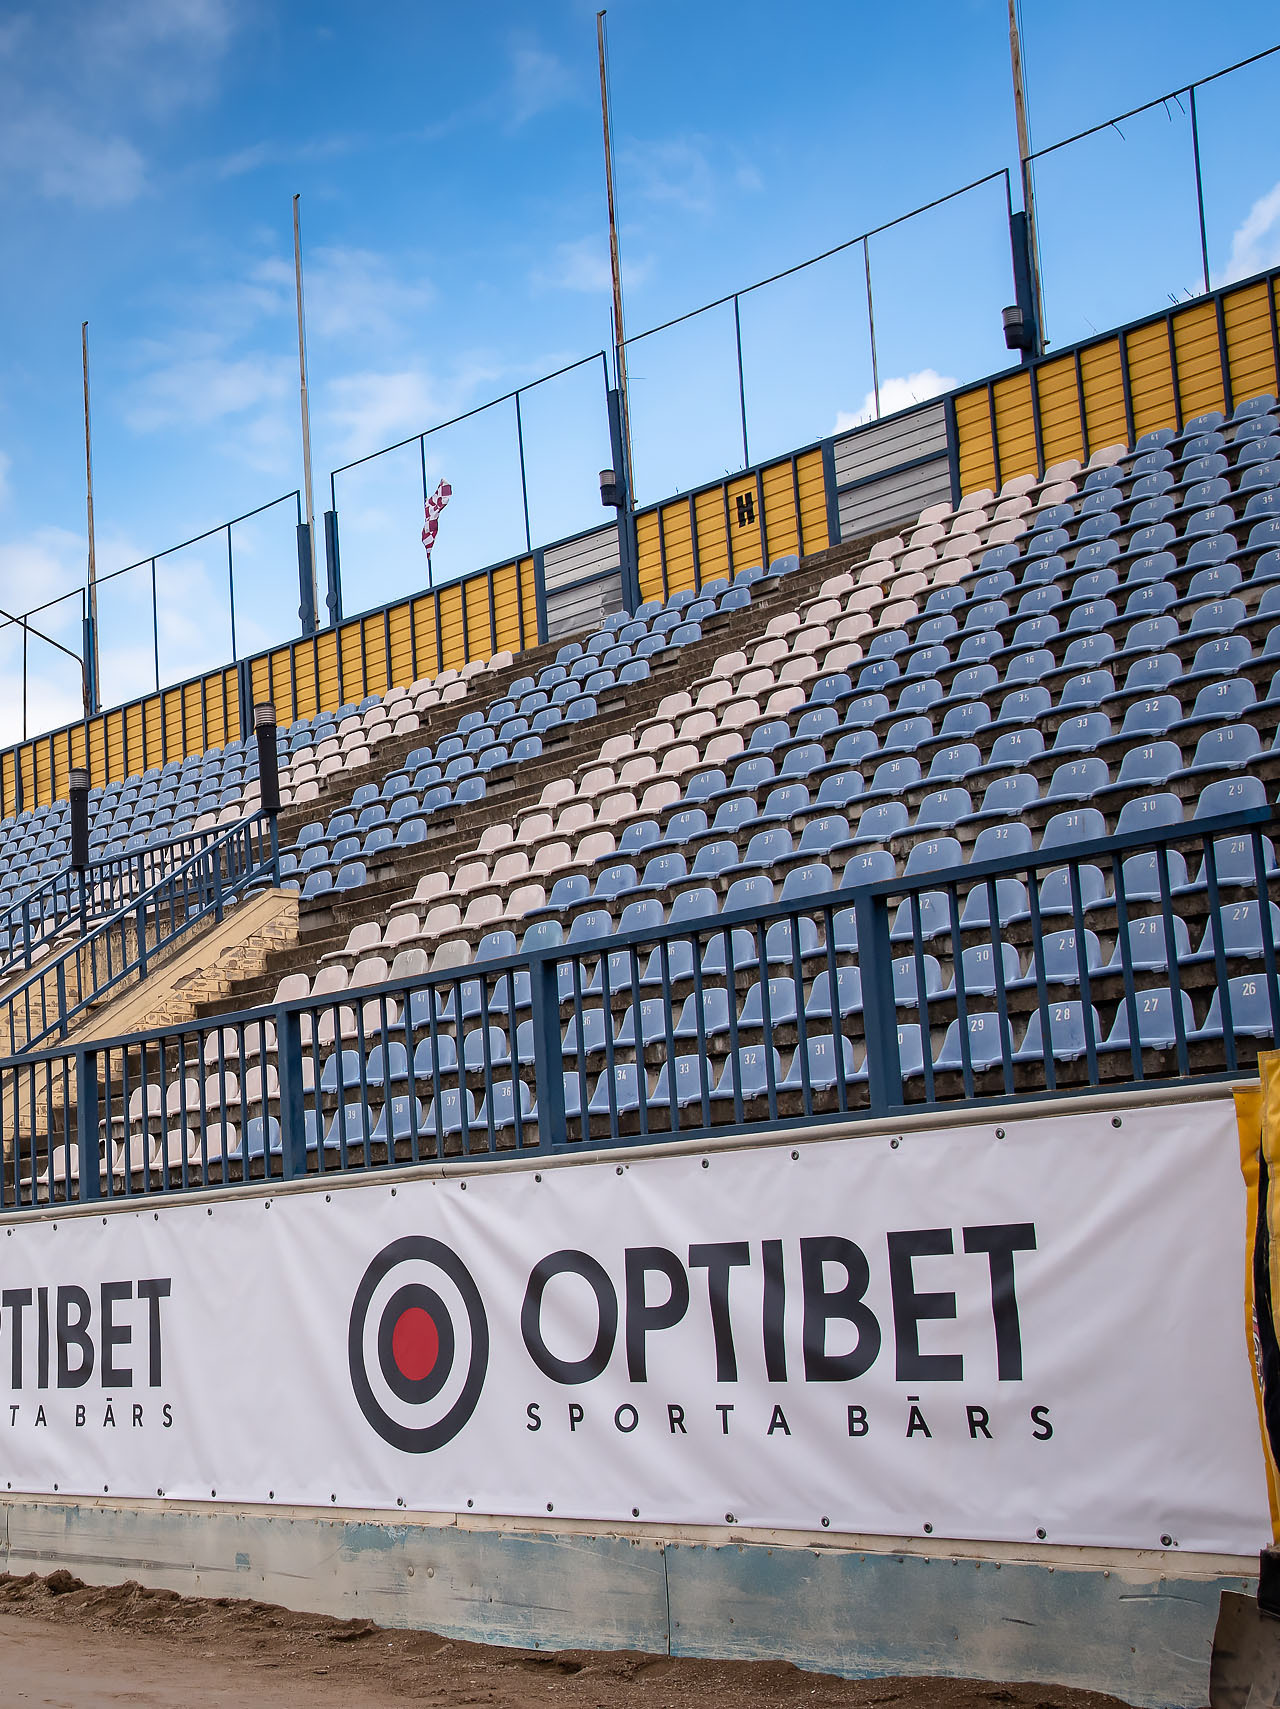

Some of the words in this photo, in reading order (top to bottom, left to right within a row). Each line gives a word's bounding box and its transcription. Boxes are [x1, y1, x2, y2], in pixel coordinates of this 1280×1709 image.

[1262, 495, 1273, 504] 35
[736, 492, 755, 528] H
[1205, 511, 1215, 521] 36
[1145, 529, 1155, 539] 37
[1142, 589, 1153, 600] 35
[1084, 607, 1094, 616] 36
[1213, 605, 1223, 615] 33
[1082, 639, 1094, 648] 35
[1214, 642, 1229, 652] 32
[1025, 655, 1034, 664] 36
[1147, 659, 1159, 670] 33
[1217, 687, 1227, 696] 31
[1145, 700, 1159, 712] 32
[1077, 718, 1088, 728] 33
[1217, 730, 1233, 742] 30
[1143, 749, 1153, 759] 31
[1071, 764, 1086, 775] 32
[1229, 784, 1243, 796] 29
[1141, 801, 1156, 813] 30
[1066, 815, 1078, 826] 31
[996, 829, 1007, 839] 32
[927, 843, 938, 854] 33
[861, 858, 872, 867] 34
[1232, 907, 1249, 920] 27
[1139, 922, 1156, 934] 28
[1059, 937, 1075, 950] 29
[976, 950, 989, 962] 30
[898, 963, 909, 975] 31
[1242, 982, 1256, 996] 26
[1144, 998, 1159, 1012] 27
[1055, 1008, 1070, 1021] 28
[971, 1019, 984, 1032] 29
[815, 1044, 825, 1055] 31
[744, 1053, 756, 1064] 32
[680, 1063, 689, 1074] 33
[617, 1070, 627, 1080] 34
[502, 1086, 511, 1096] 36
[446, 1096, 456, 1106] 37
[395, 1104, 403, 1113] 38
[347, 1110, 356, 1120] 39
[521, 1222, 1037, 1385] OPTIBET
[75, 1397, 173, 1427] BĀRS
[526, 1402, 792, 1436] SPORTA
[847, 1395, 1054, 1440] BĀRS
